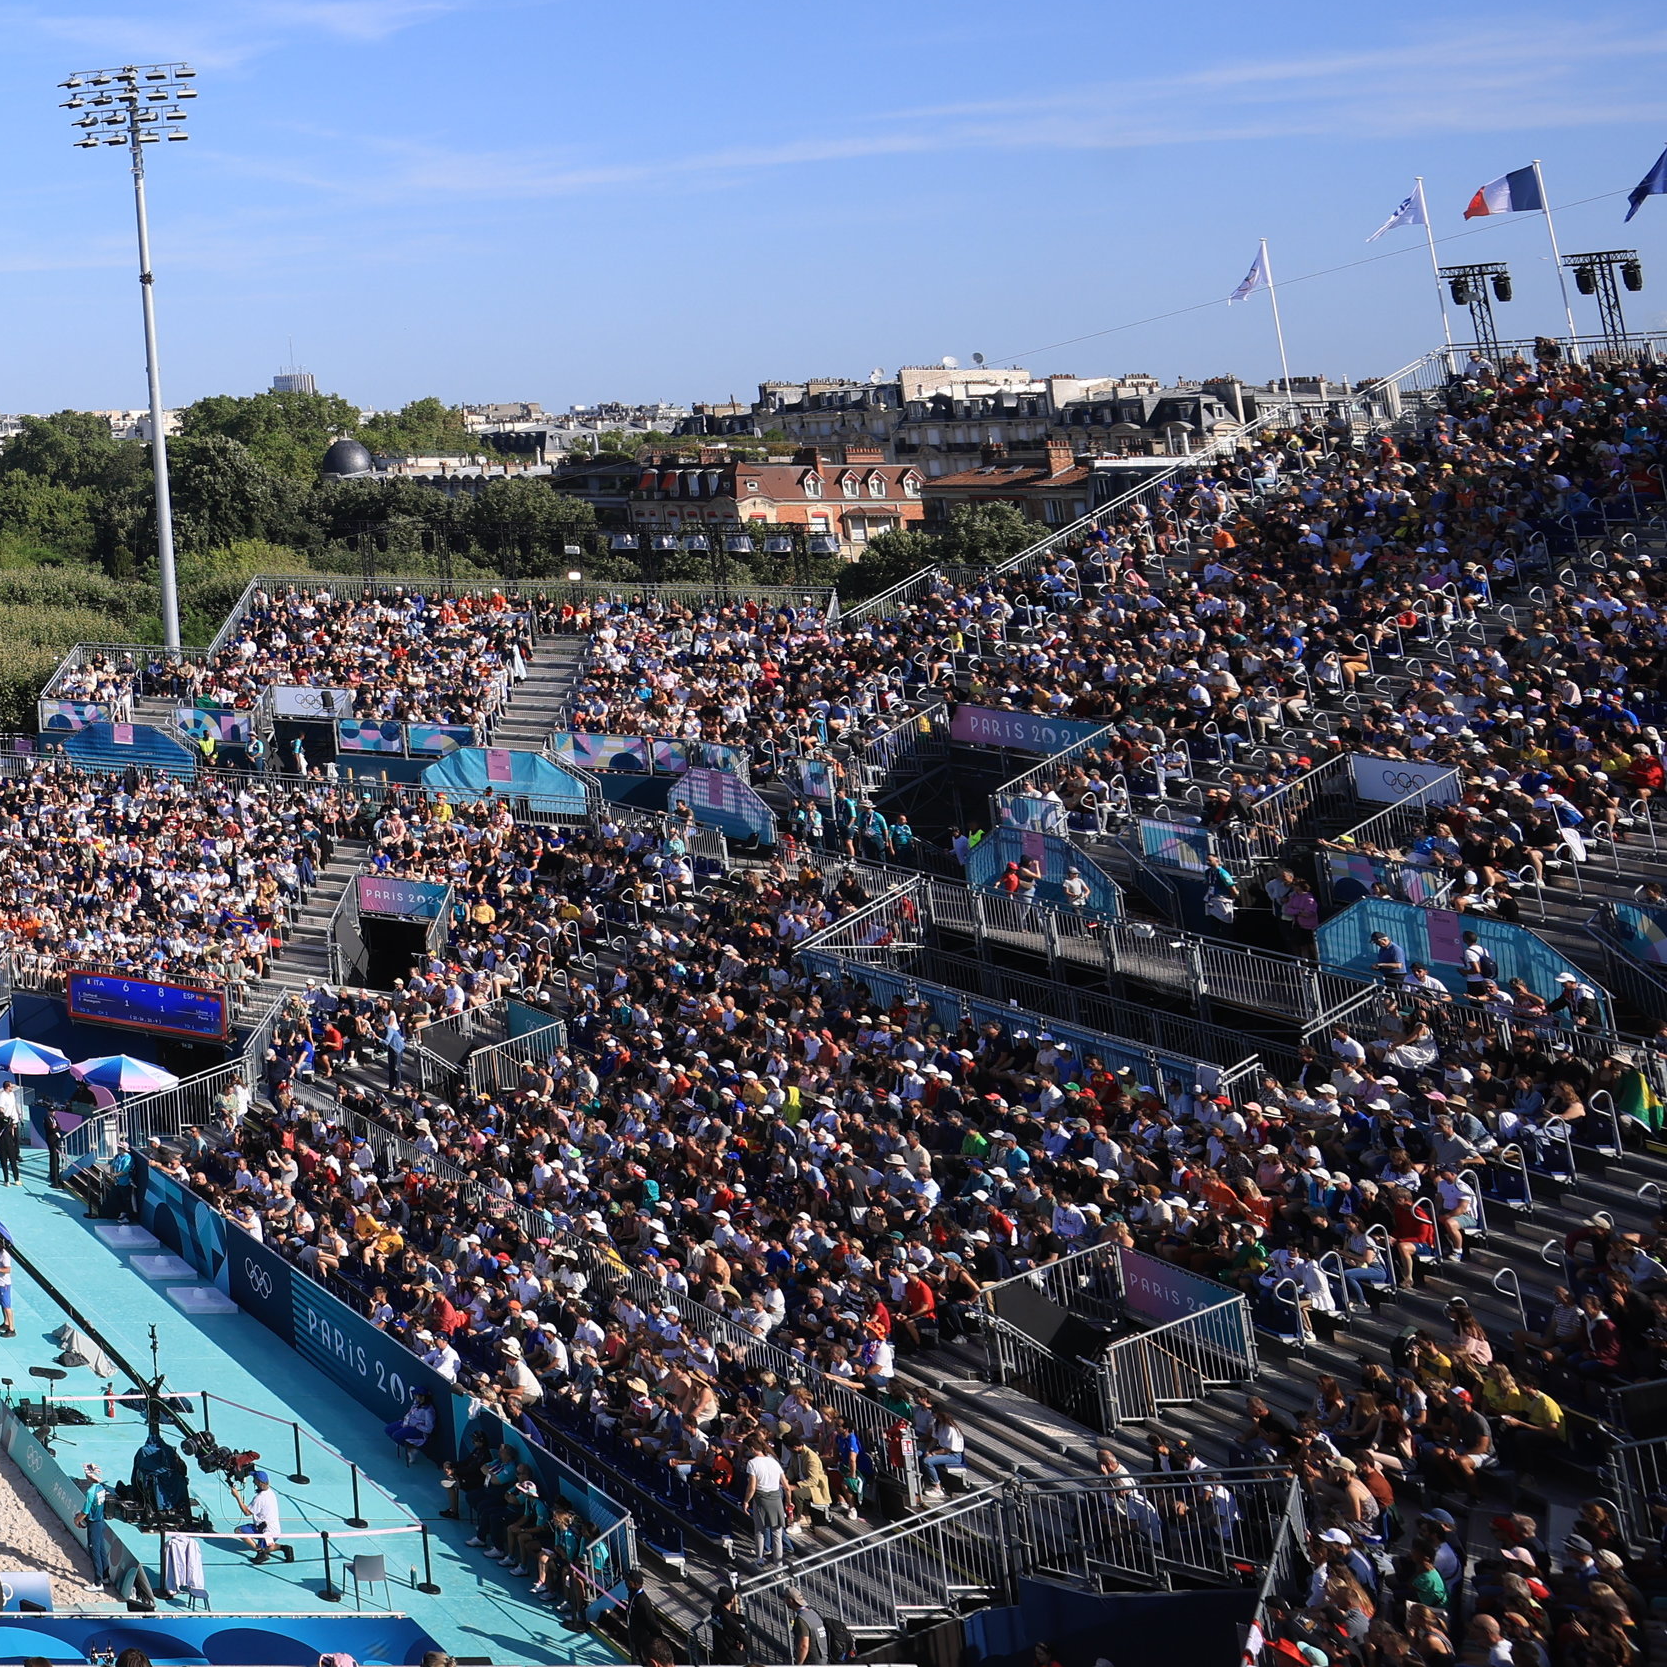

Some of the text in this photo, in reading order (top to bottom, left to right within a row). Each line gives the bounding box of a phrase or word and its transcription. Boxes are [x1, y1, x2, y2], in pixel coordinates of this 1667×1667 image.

[93, 979, 105, 987] ITA
[123, 982, 130, 992] 6
[158, 987, 165, 998] 8
[183, 992, 195, 1000] ESP
